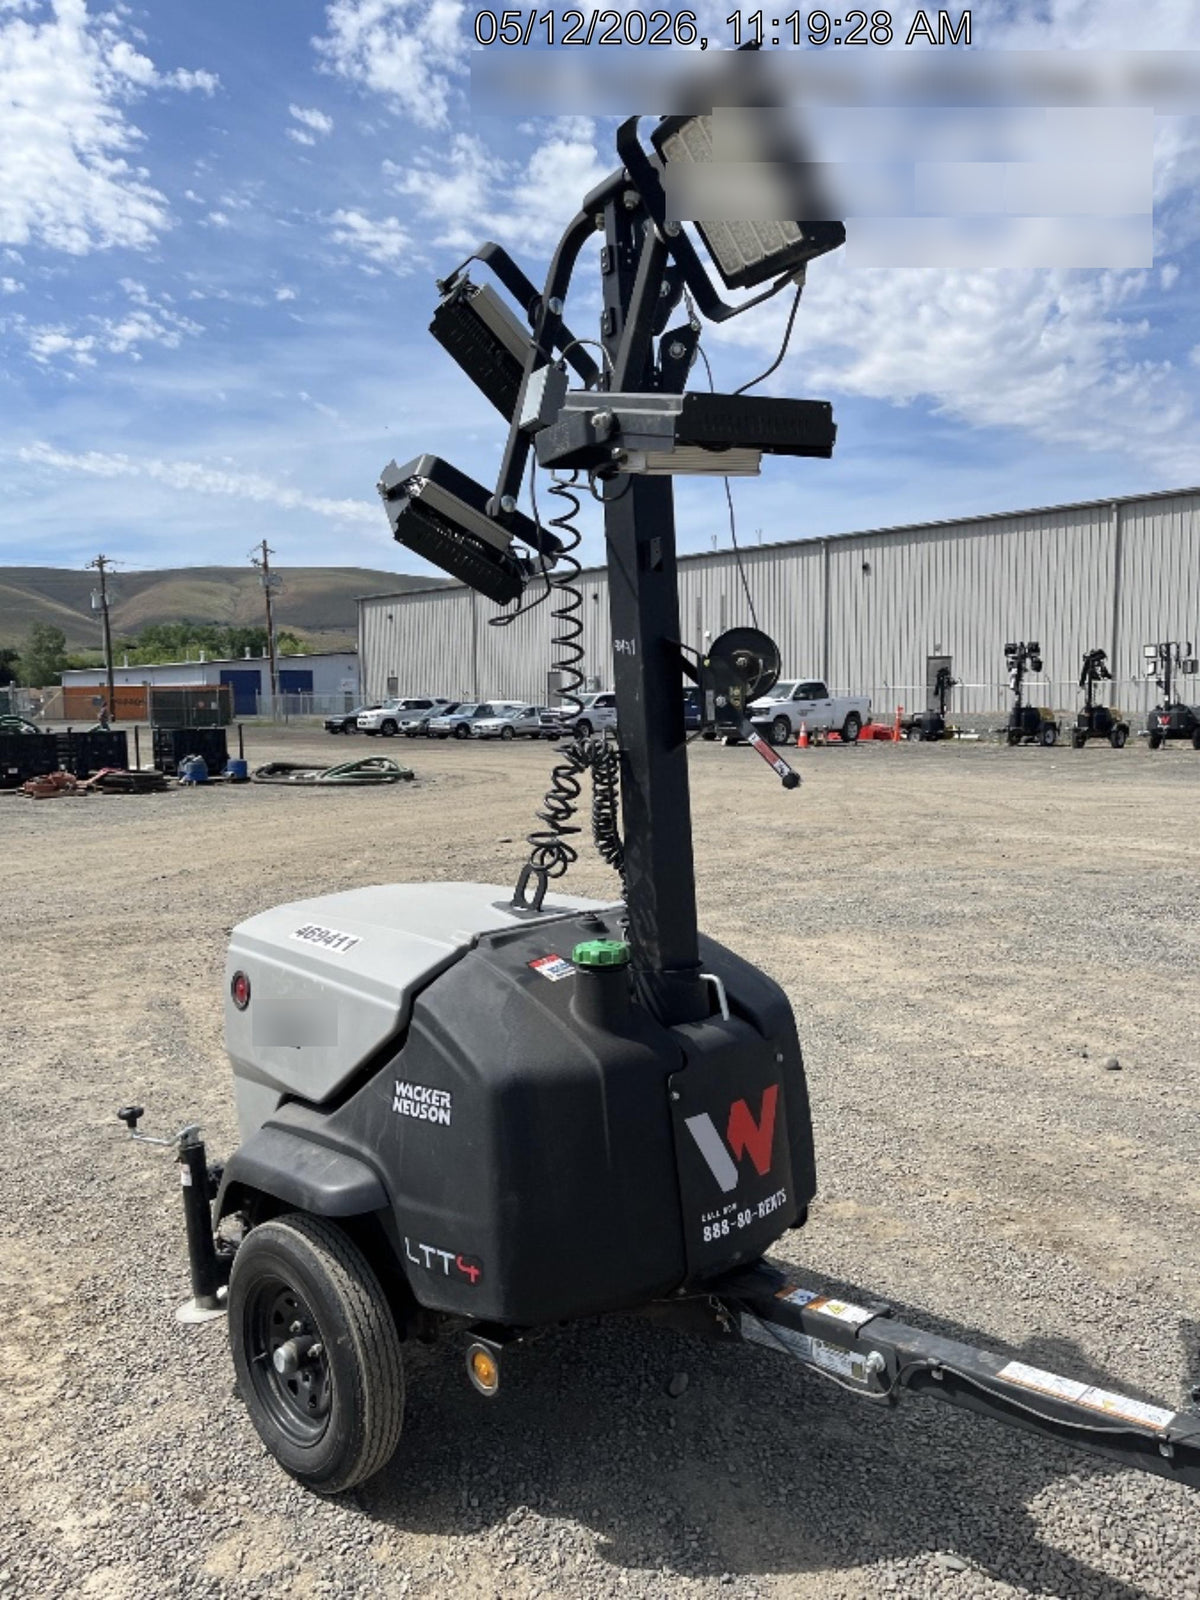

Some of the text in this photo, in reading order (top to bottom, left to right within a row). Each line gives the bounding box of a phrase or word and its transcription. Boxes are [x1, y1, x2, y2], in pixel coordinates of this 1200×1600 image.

[295, 925, 360, 952] 469411
[395, 1080, 451, 1109] WACKER
[392, 1096, 451, 1127] NEUSON
[684, 1083, 779, 1193] W
[404, 1236, 481, 1283] LTT4
